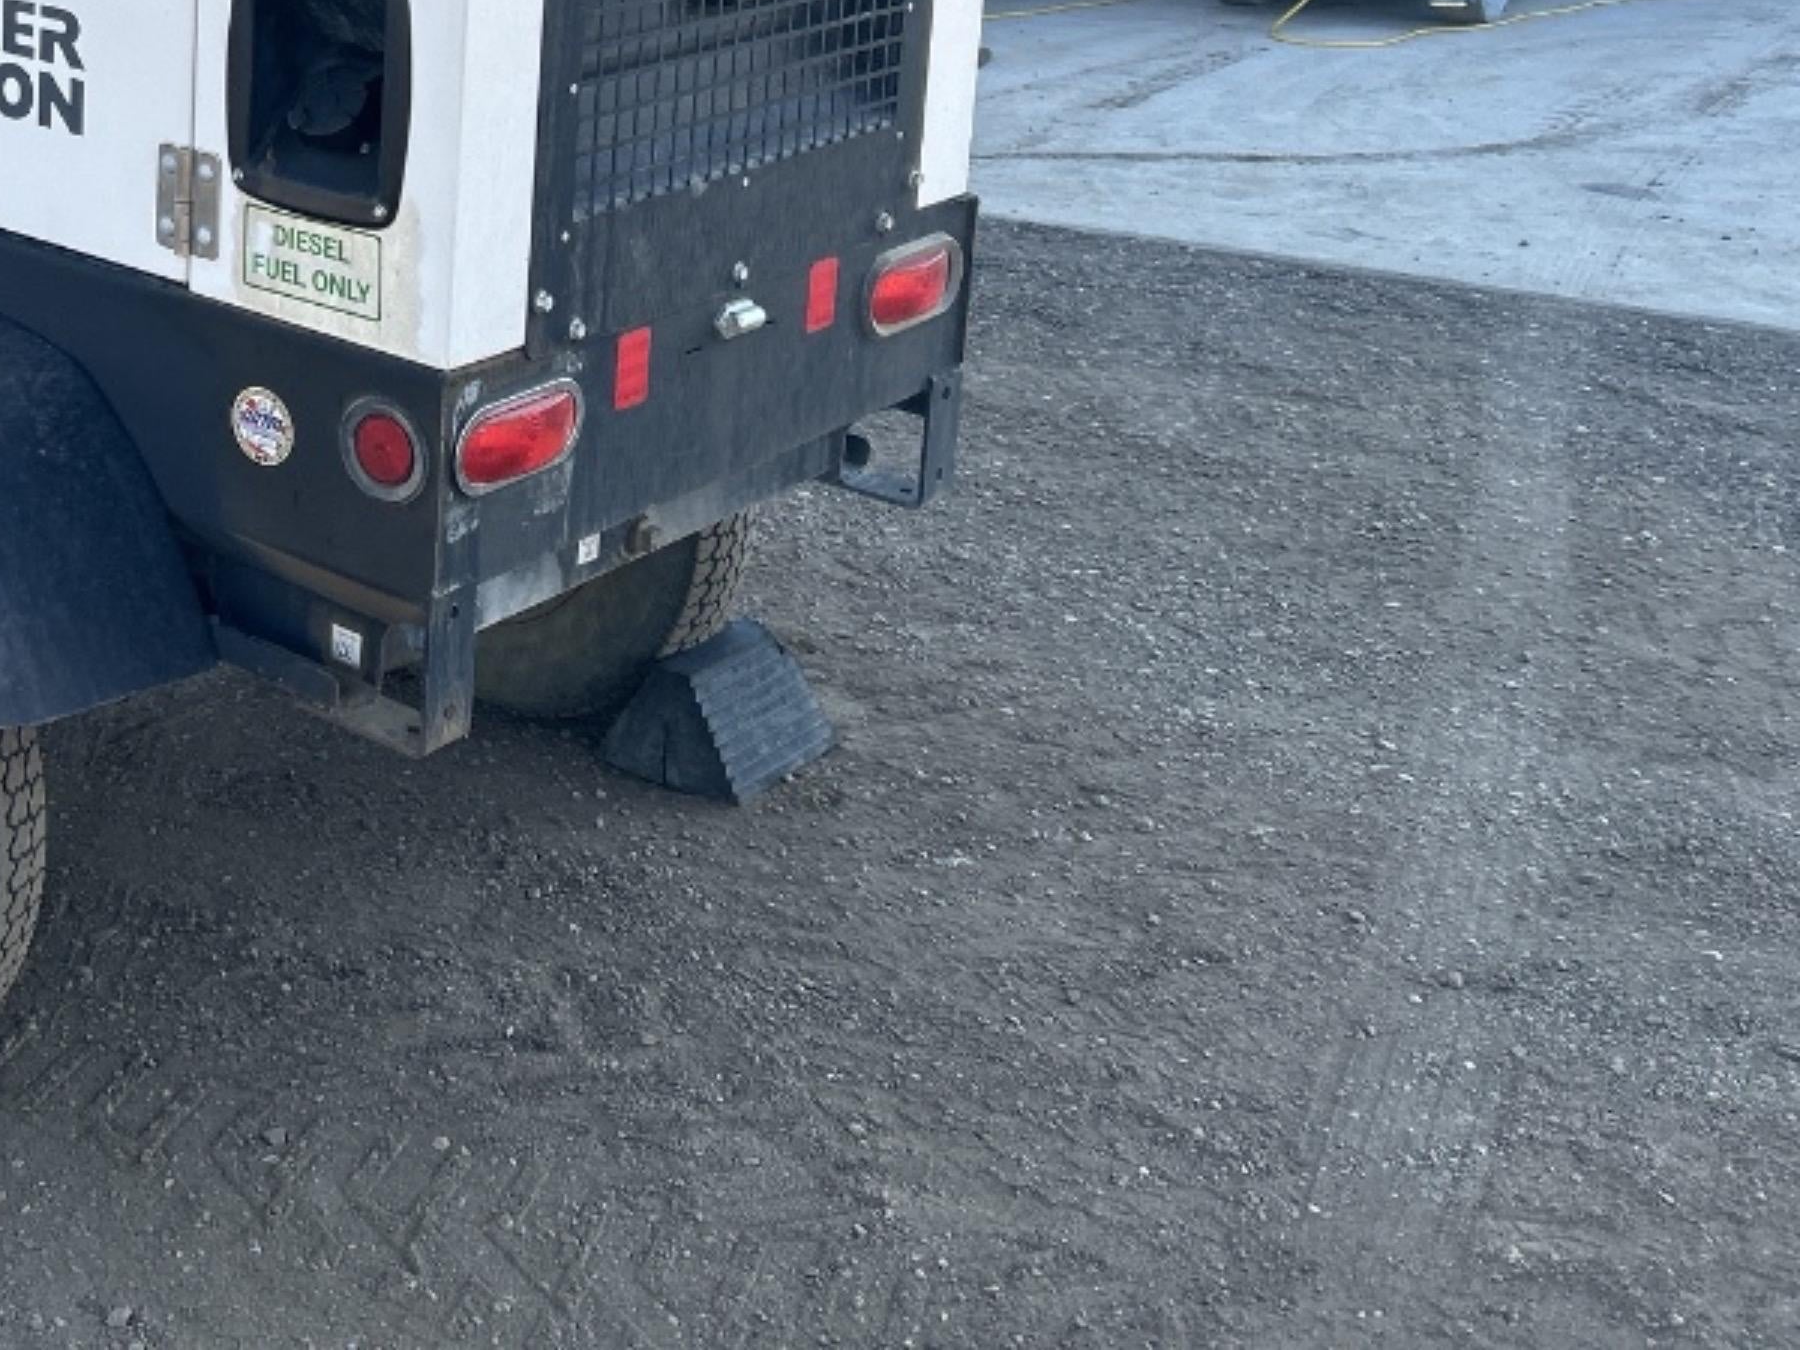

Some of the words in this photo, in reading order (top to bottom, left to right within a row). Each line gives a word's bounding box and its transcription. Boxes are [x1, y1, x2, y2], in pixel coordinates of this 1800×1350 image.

[273, 223, 350, 264] DIESEL
[251, 252, 306, 288] FUEL
[312, 269, 370, 304] ONLY
